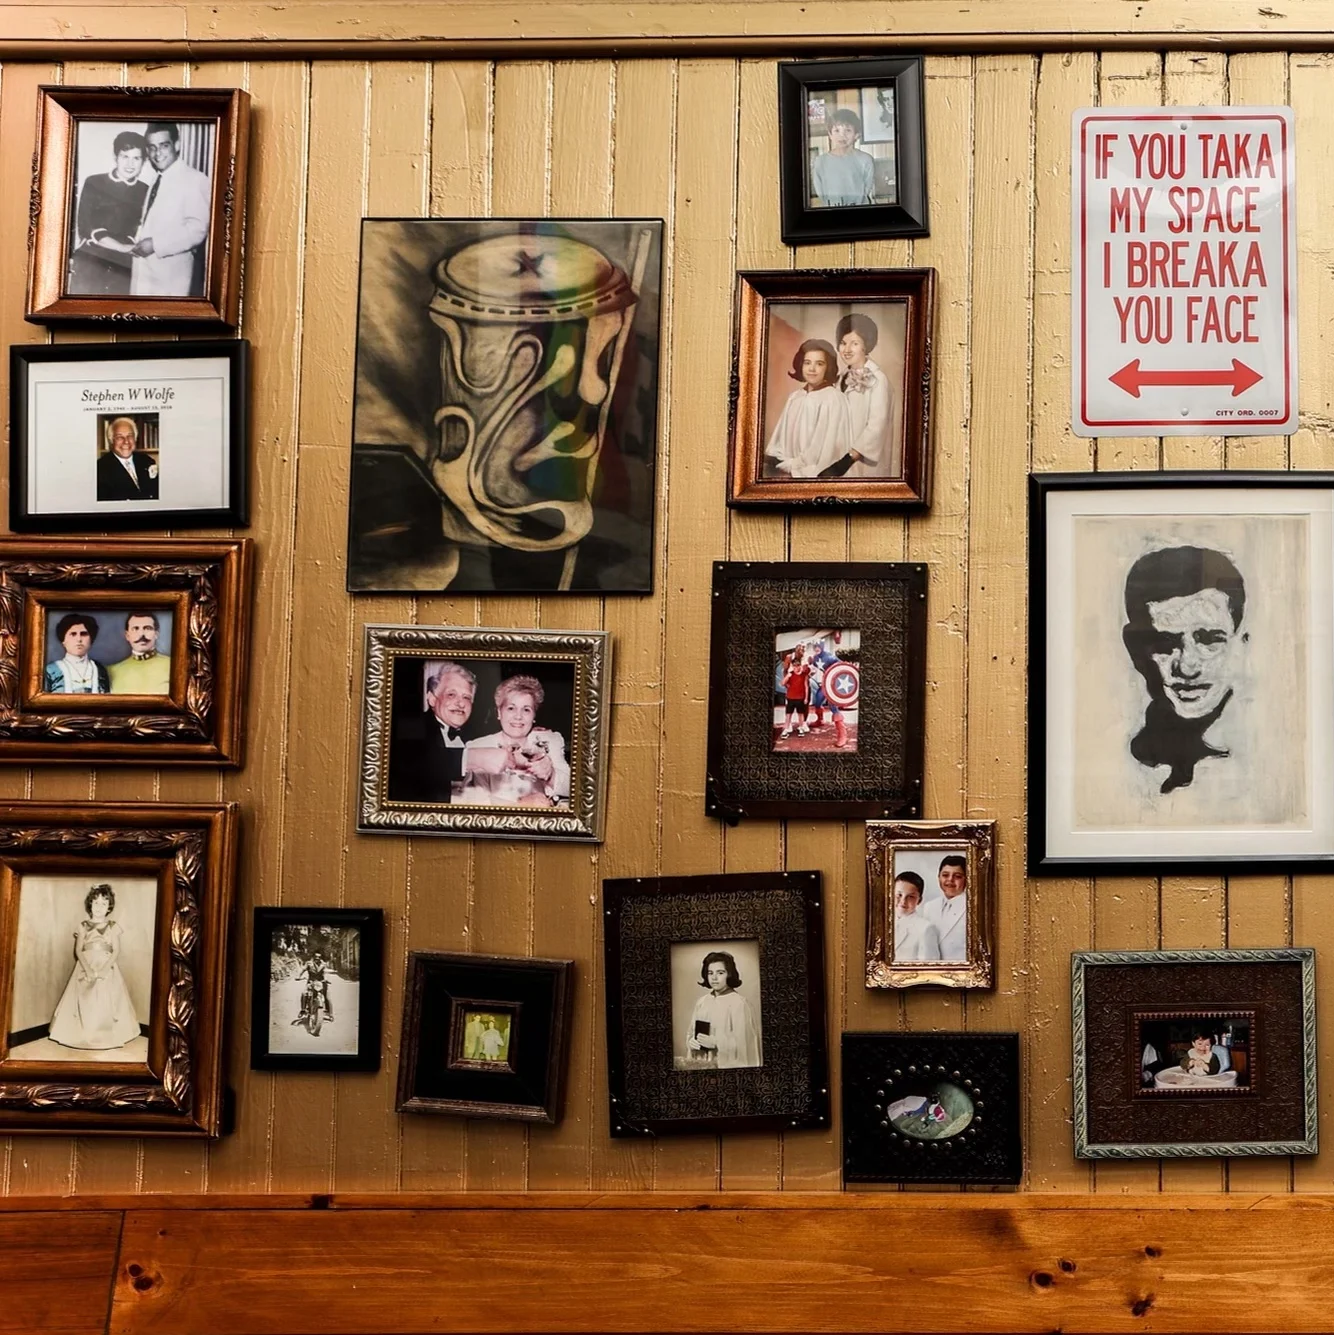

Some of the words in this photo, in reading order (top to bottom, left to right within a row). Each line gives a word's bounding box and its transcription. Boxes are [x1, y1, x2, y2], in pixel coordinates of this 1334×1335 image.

[1095, 134, 1118, 179] IF
[1128, 132, 1186, 179] YOU
[1198, 133, 1276, 179] TAKA
[1110, 187, 1153, 233] MY
[1167, 186, 1261, 234] SPACE
[1103, 242, 1111, 288] I
[1127, 241, 1267, 288] BREAKA
[1113, 295, 1173, 344] YOU
[1186, 295, 1259, 343] FACE
[81, 389, 124, 405] Stephen
[128, 388, 141, 400] W
[143, 387, 175, 404] Wolfe
